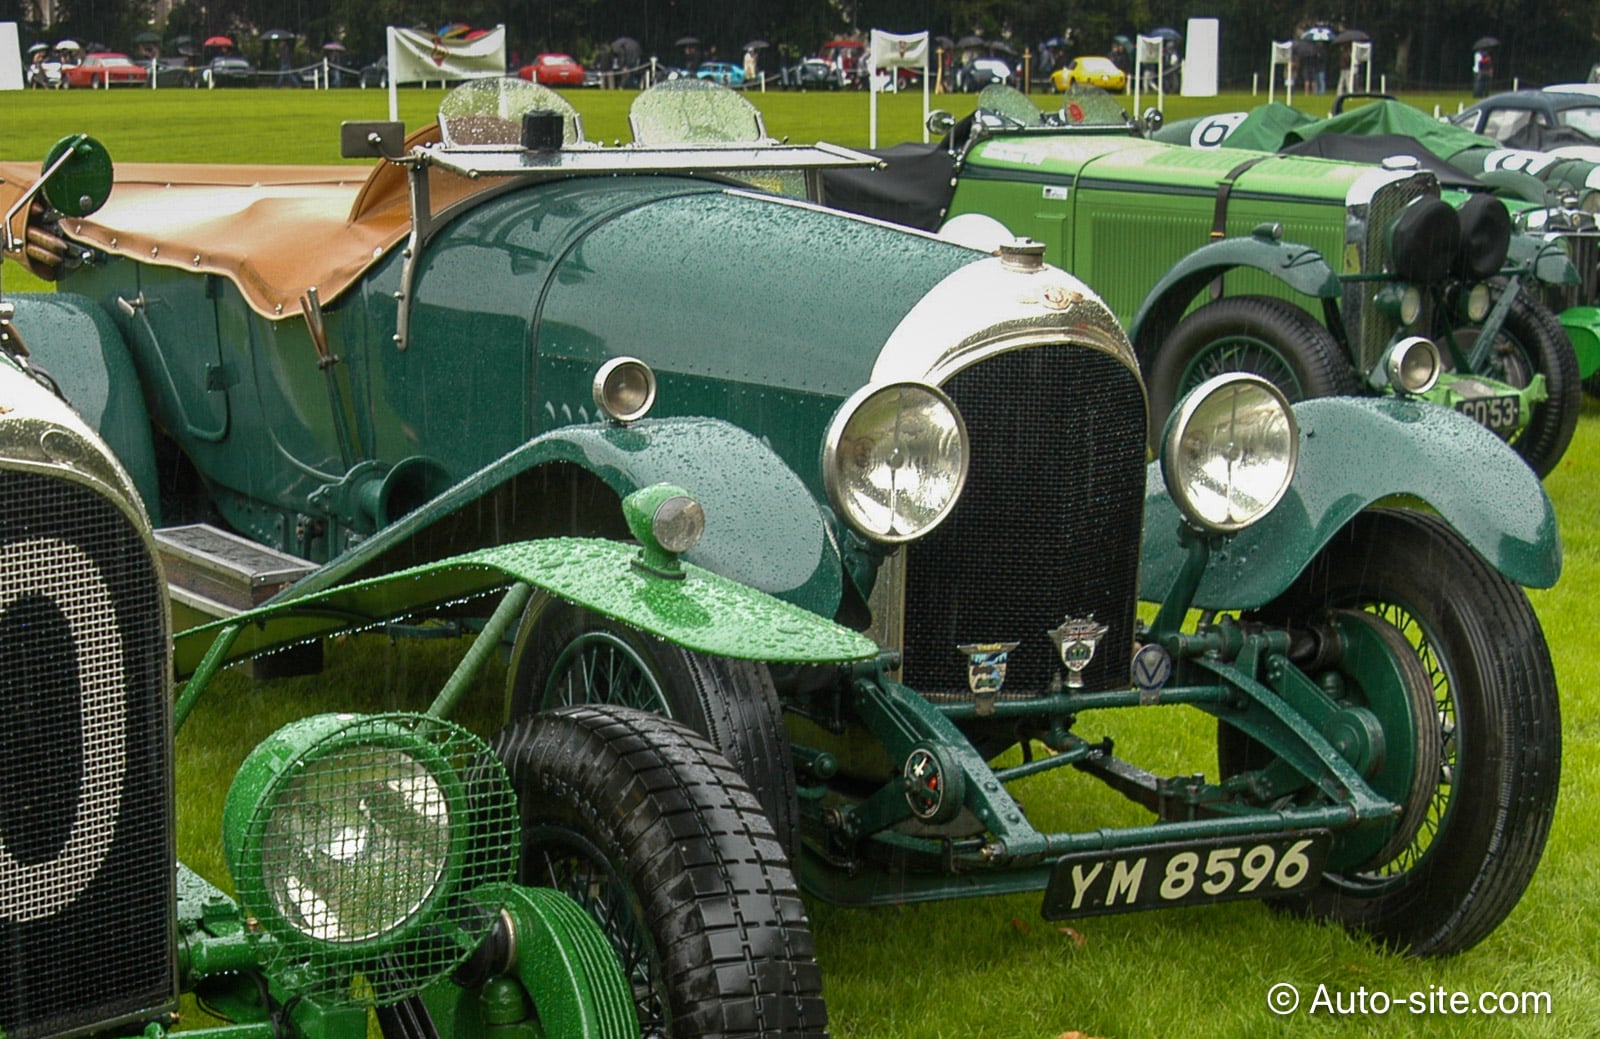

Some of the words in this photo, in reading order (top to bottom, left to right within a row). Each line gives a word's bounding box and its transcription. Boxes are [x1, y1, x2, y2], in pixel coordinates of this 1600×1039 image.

[1490, 397, 1514, 428] 53
[1070, 857, 1148, 910] YM
[1159, 839, 1314, 901] 8596
